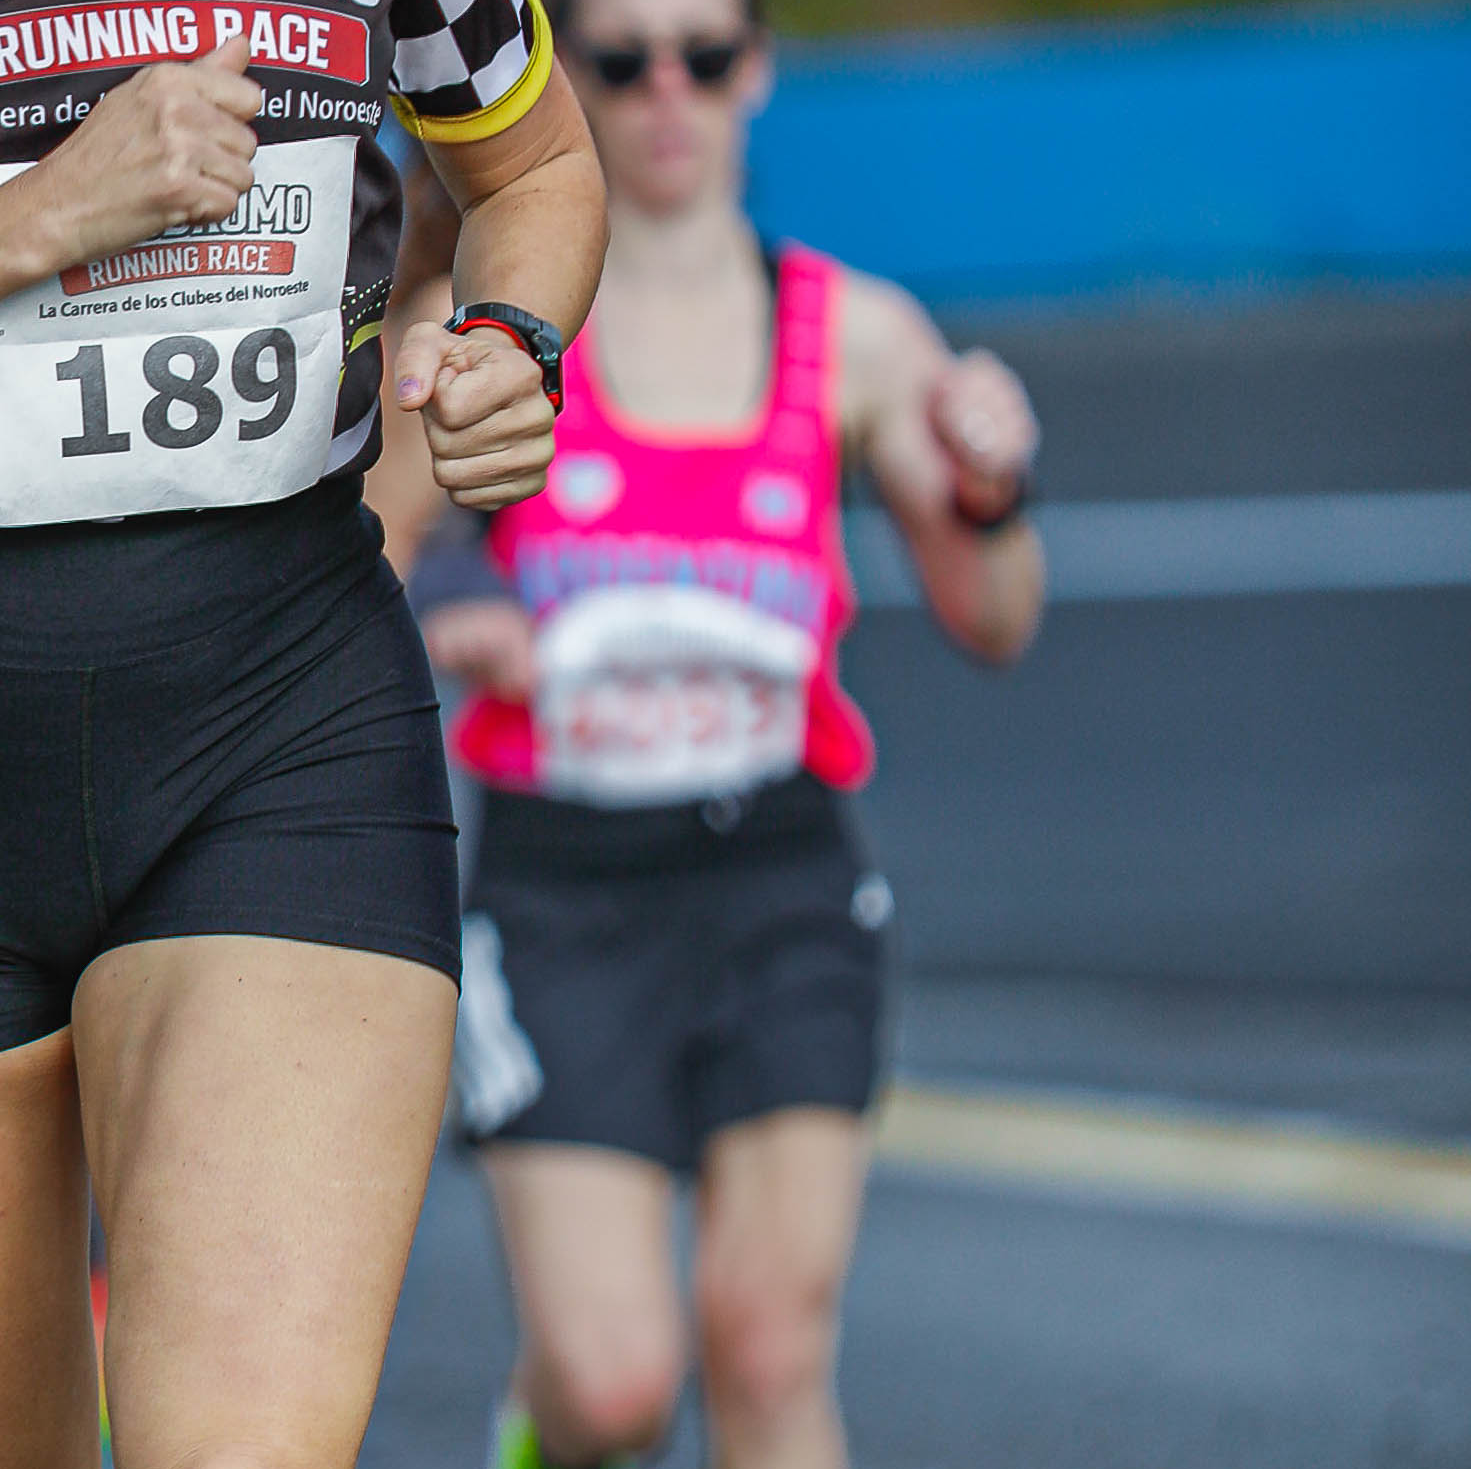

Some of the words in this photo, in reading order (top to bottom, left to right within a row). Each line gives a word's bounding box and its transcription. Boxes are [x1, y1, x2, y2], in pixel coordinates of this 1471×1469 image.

[213, 7, 330, 69] RACE
[54, 94, 90, 123] de
[298, 90, 382, 126] Noroeste
[87, 247, 199, 288] RUNNING
[208, 244, 271, 272] RACE
[39, 303, 57, 319] La
[60, 300, 118, 318] Carrera
[122, 295, 141, 312] de
[145, 293, 168, 310] los
[171, 289, 222, 307] Clubes
[226, 286, 249, 301] del
[253, 279, 310, 300] Noroeste
[55, 327, 297, 457] 189
